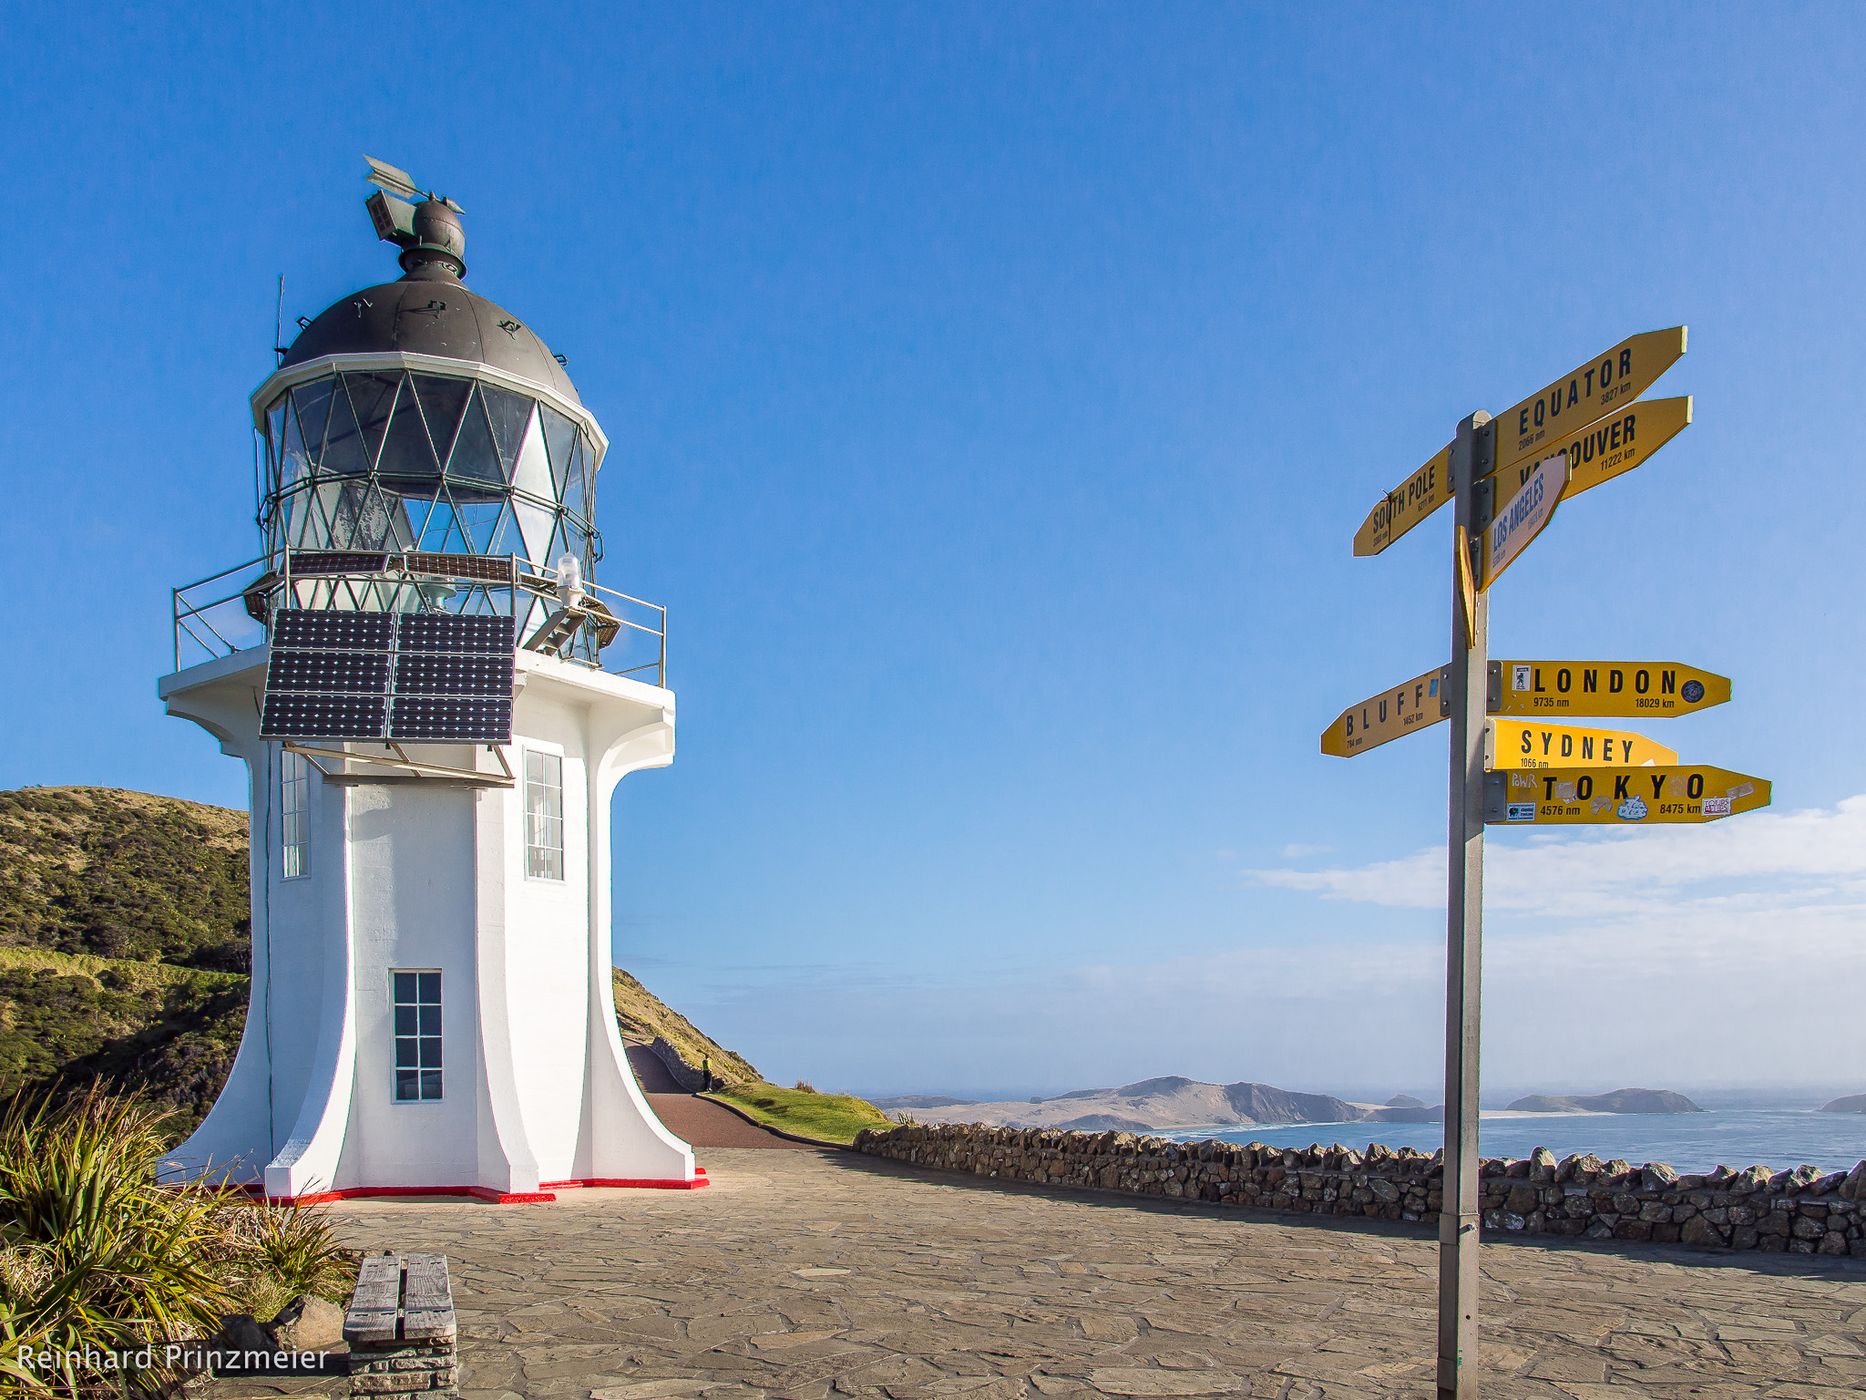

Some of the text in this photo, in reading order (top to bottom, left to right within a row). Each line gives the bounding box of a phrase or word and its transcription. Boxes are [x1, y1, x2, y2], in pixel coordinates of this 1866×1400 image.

[1520, 348, 1631, 435] EQUATOR
[1601, 382, 1631, 405] 3827 km
[1520, 415, 1636, 487] VOUVER
[1601, 448, 1635, 471] 11222 km
[1373, 465, 1435, 534] SOUTH POLE
[1493, 515, 1507, 552] LOS
[1508, 473, 1544, 536] ANGELES
[1534, 668, 1675, 694] LONDON
[1346, 684, 1423, 737] BLUFF
[1533, 697, 1569, 707] 9735 nm
[1636, 698, 1674, 708] 18029 km
[1415, 712, 1423, 721] km
[1521, 730, 1633, 763] SYDNEY
[1520, 758, 1536, 768] 1066
[1543, 774, 1704, 800] TOKYO
[1541, 805, 1563, 815] 4576
[1566, 807, 1580, 815] nm
[1660, 804, 1684, 814] 8475
[1687, 804, 1701, 814] km
